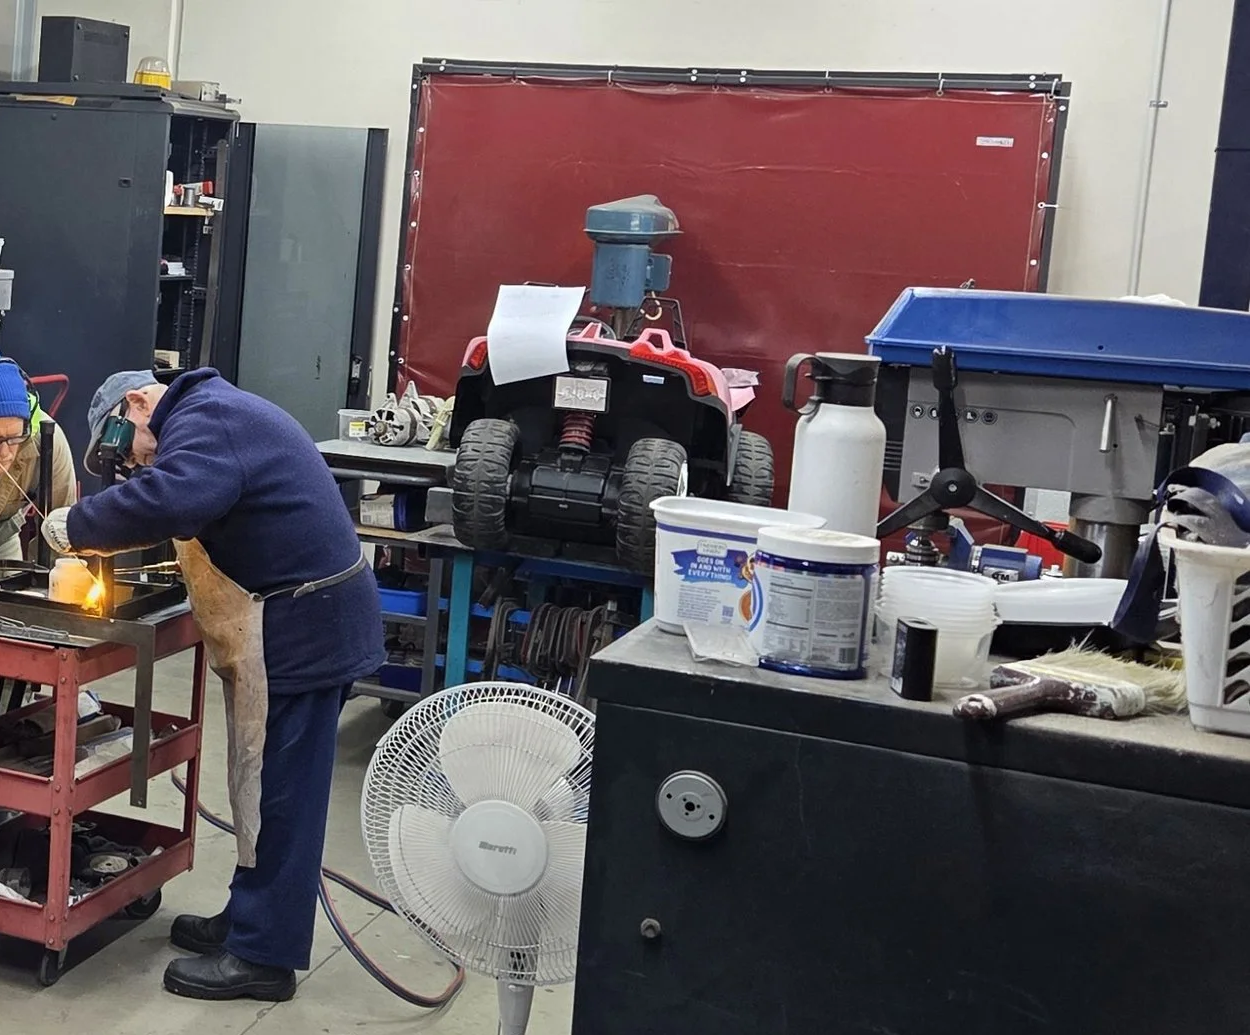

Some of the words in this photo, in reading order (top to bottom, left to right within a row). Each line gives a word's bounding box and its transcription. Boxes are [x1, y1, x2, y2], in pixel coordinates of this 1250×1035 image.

[697, 555, 714, 565] GOES
[698, 563, 712, 571] AND
[713, 565, 732, 574] WITH
